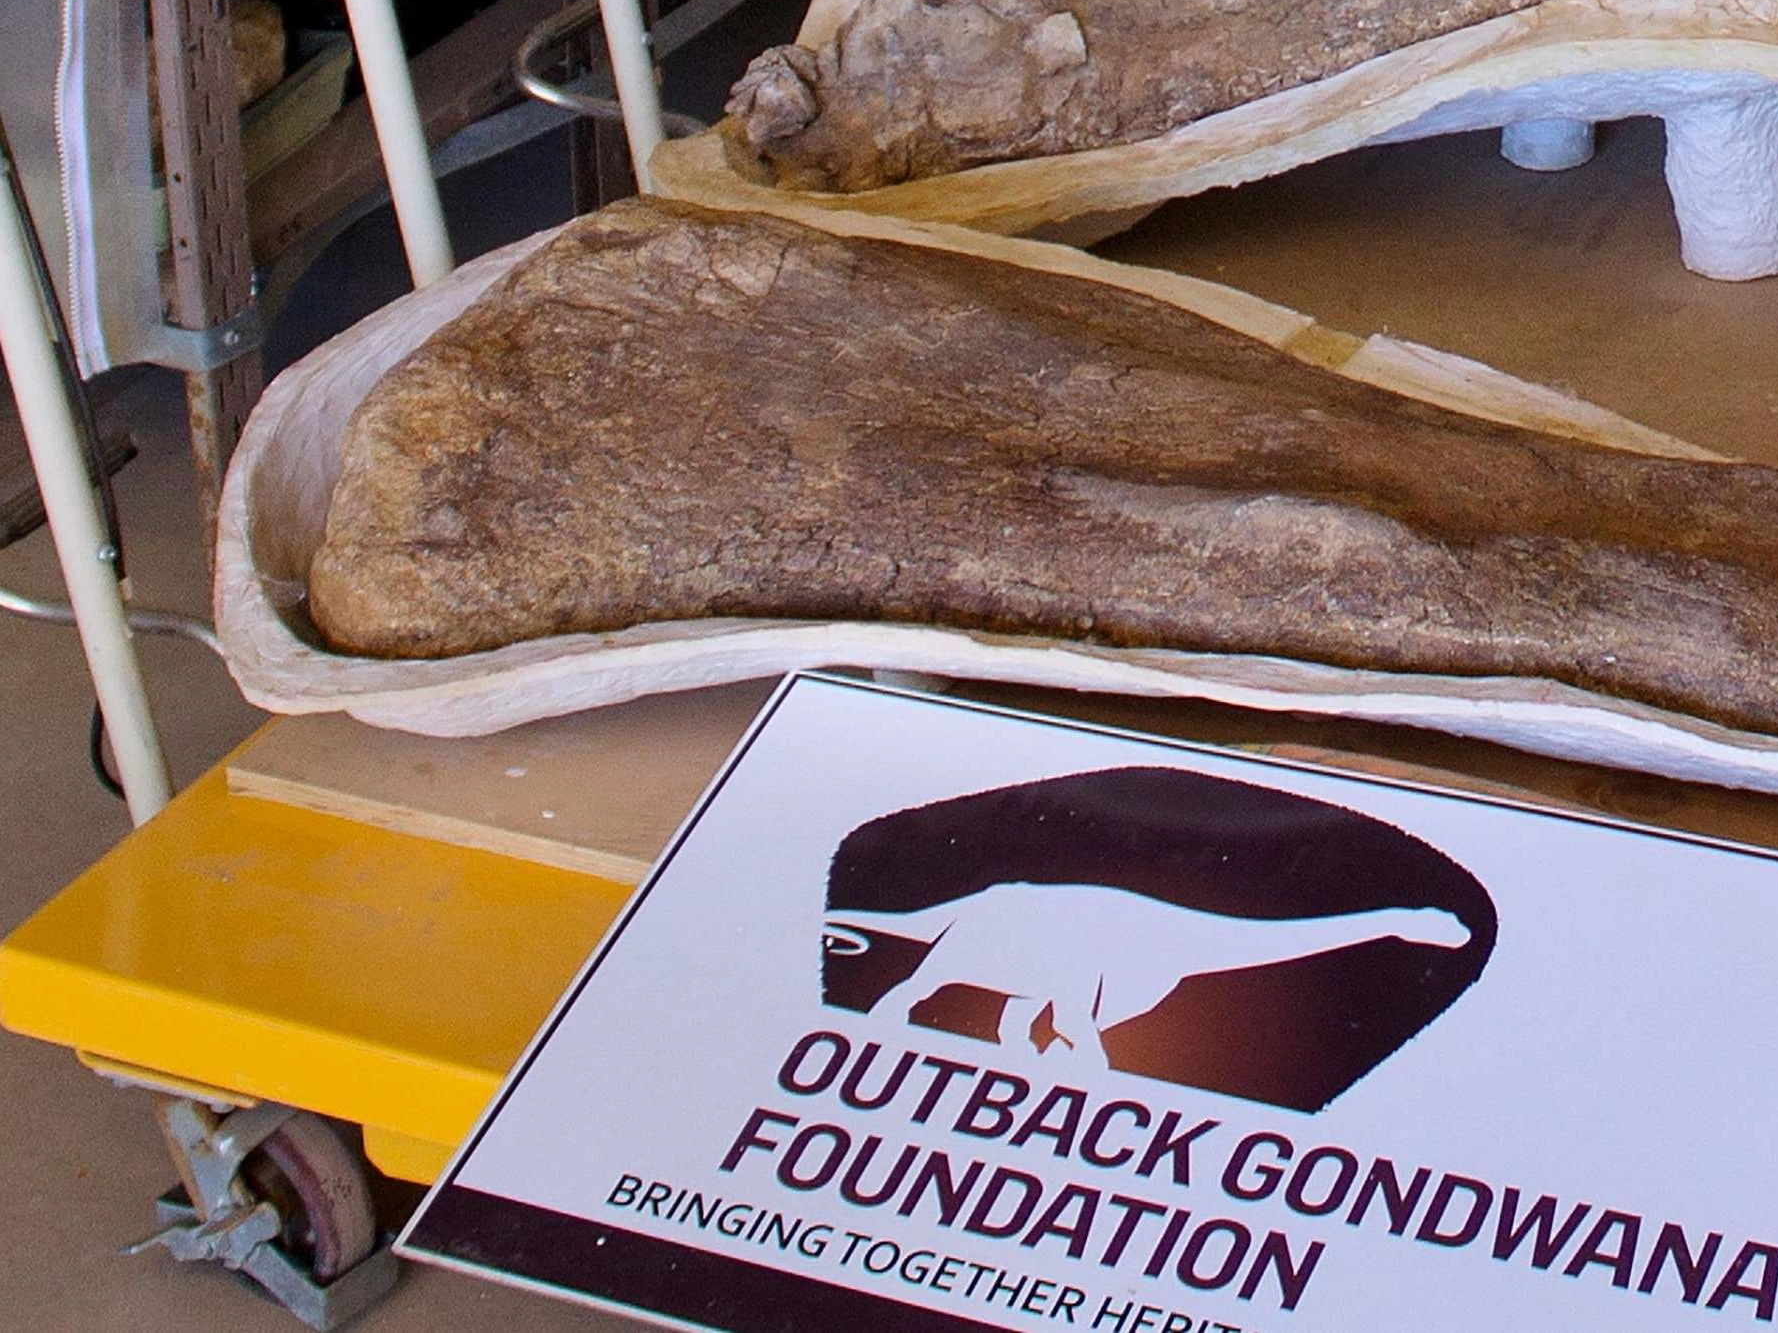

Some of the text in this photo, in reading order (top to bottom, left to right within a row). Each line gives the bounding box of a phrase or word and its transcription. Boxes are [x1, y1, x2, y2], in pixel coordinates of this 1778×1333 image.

[777, 1030, 1221, 1187] OUTBACK
[605, 1173, 834, 1259] BRINGING
[838, 1231, 1086, 1324] TOGETHER
[718, 1107, 1326, 1312] FOUNDATION
